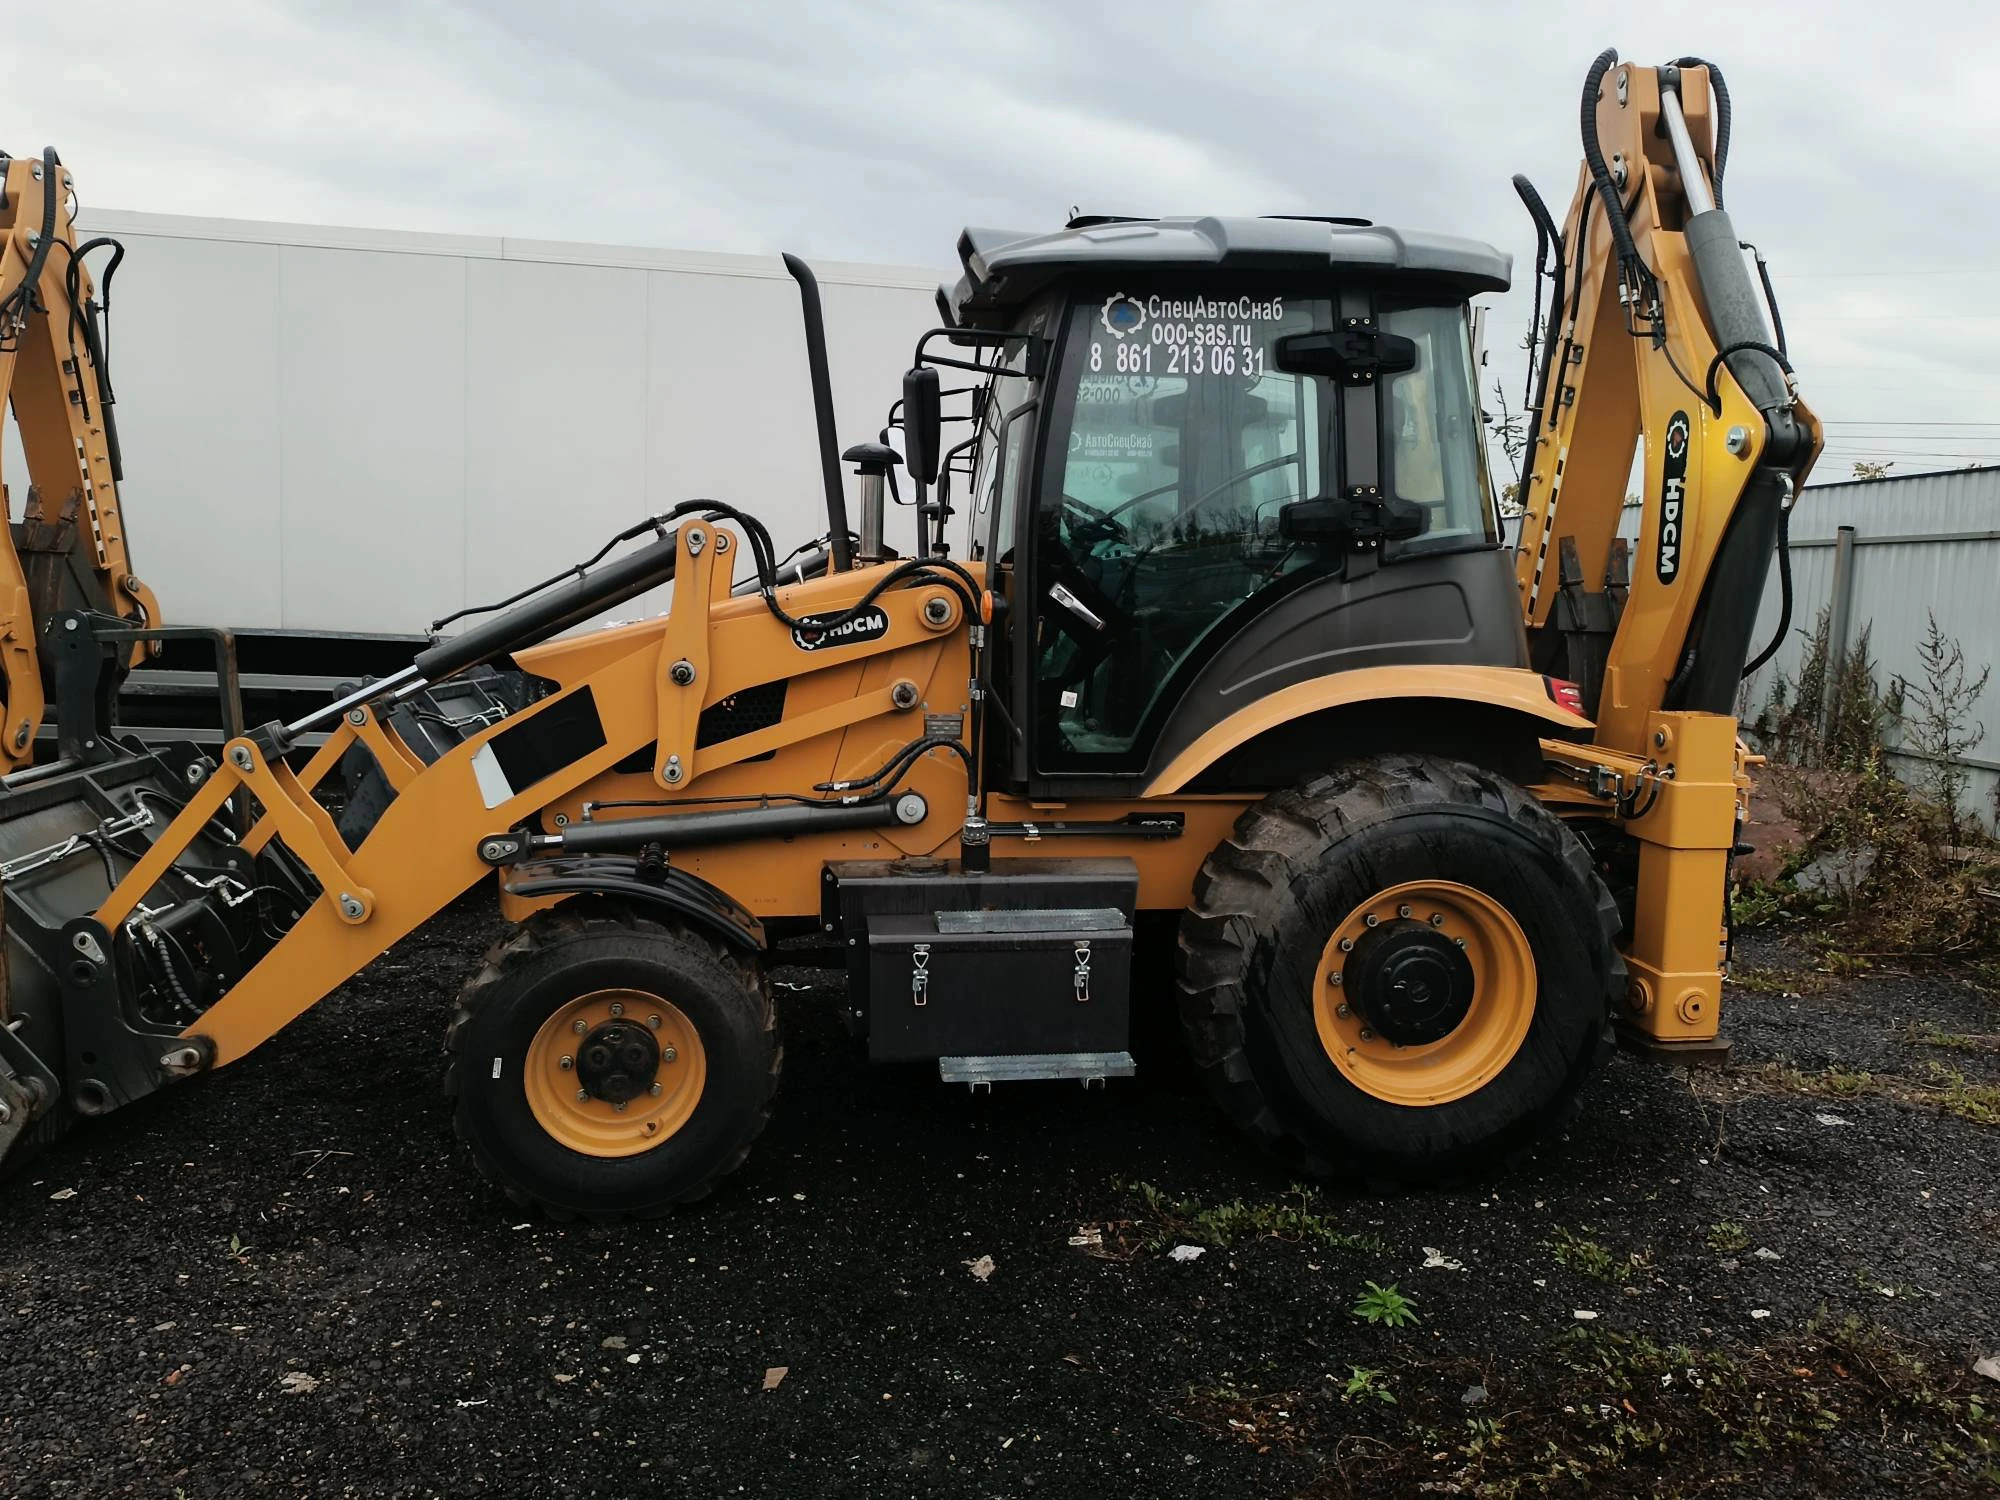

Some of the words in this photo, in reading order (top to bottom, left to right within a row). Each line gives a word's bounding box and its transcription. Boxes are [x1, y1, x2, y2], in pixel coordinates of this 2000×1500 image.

[1148, 294, 1283, 323] СпецАвтоСнаб
[1151, 323, 1251, 346] ooo-sas.ru
[1090, 342, 1102, 373] 8
[1116, 342, 1151, 373] 861
[1167, 344, 1204, 375] 213
[1211, 345, 1236, 376] 06
[1241, 346, 1264, 377] 31
[1085, 432, 1153, 450] АвтоСпецСнаб
[1660, 477, 1681, 573] HDCM
